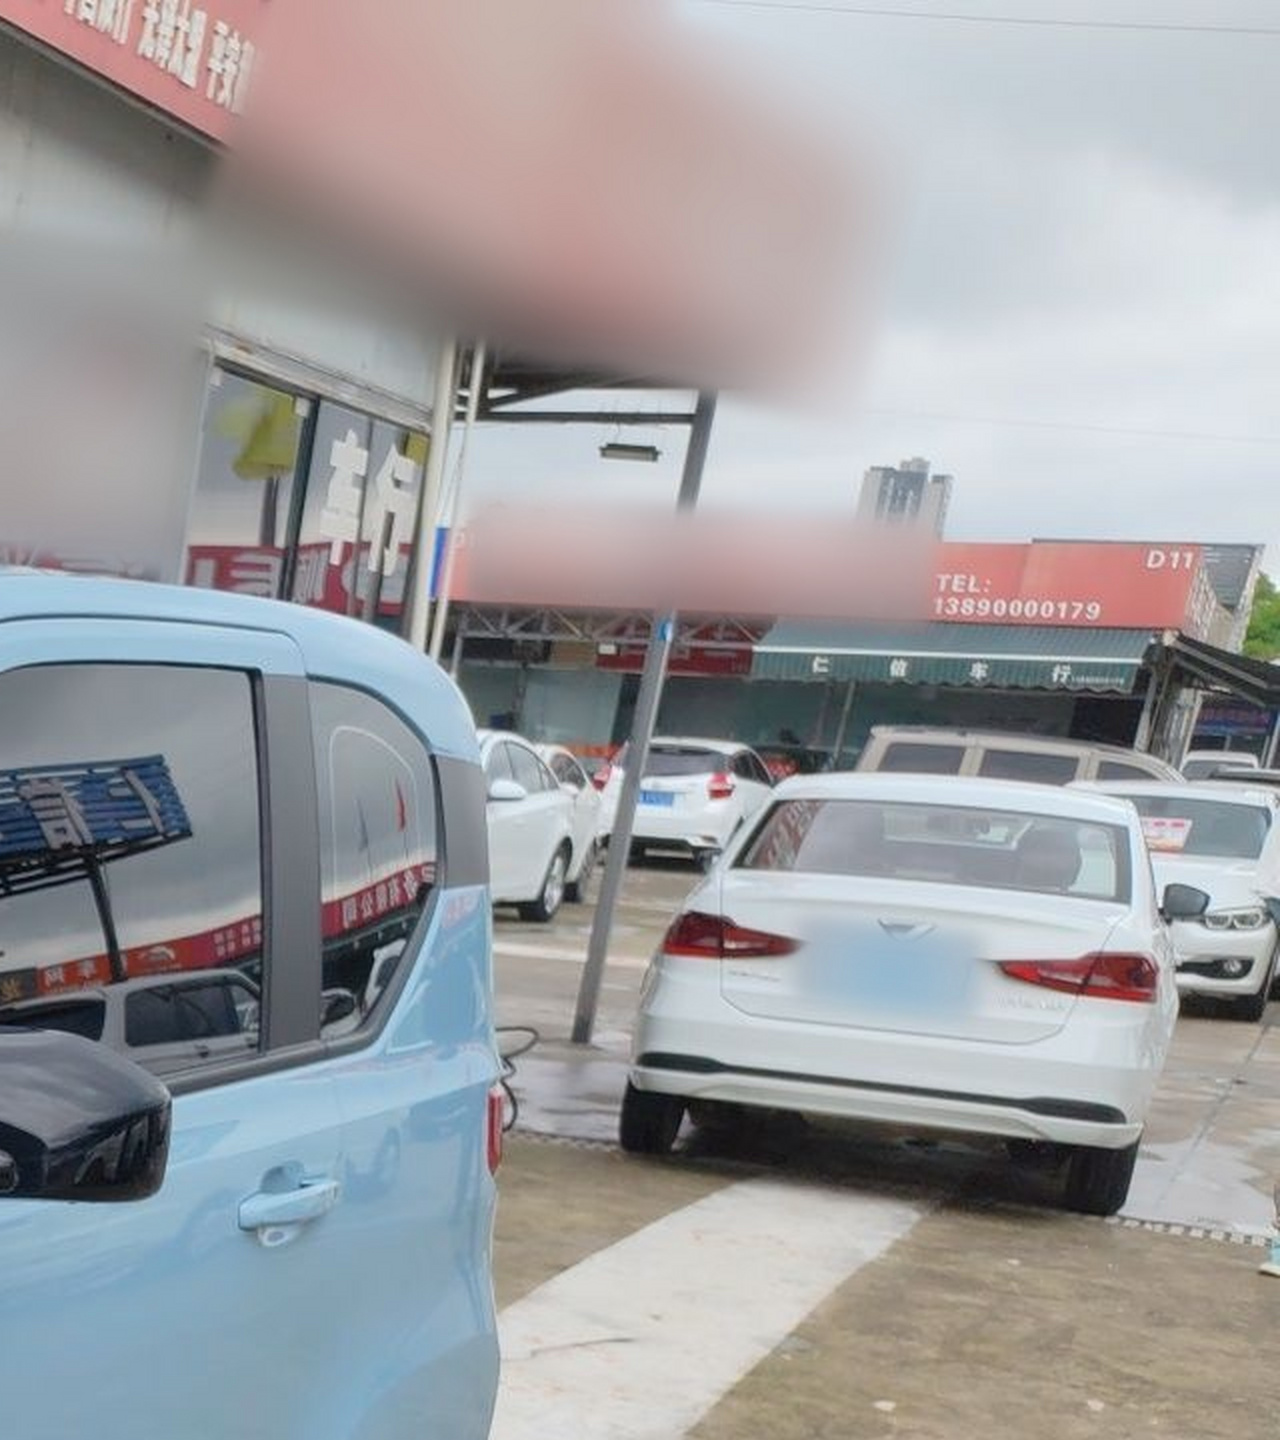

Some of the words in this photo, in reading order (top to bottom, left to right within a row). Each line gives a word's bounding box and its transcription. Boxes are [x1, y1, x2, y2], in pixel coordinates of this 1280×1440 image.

[1146, 550, 1194, 569] D11
[937, 574, 991, 593] TEL:
[935, 597, 1101, 620] 13890000179
